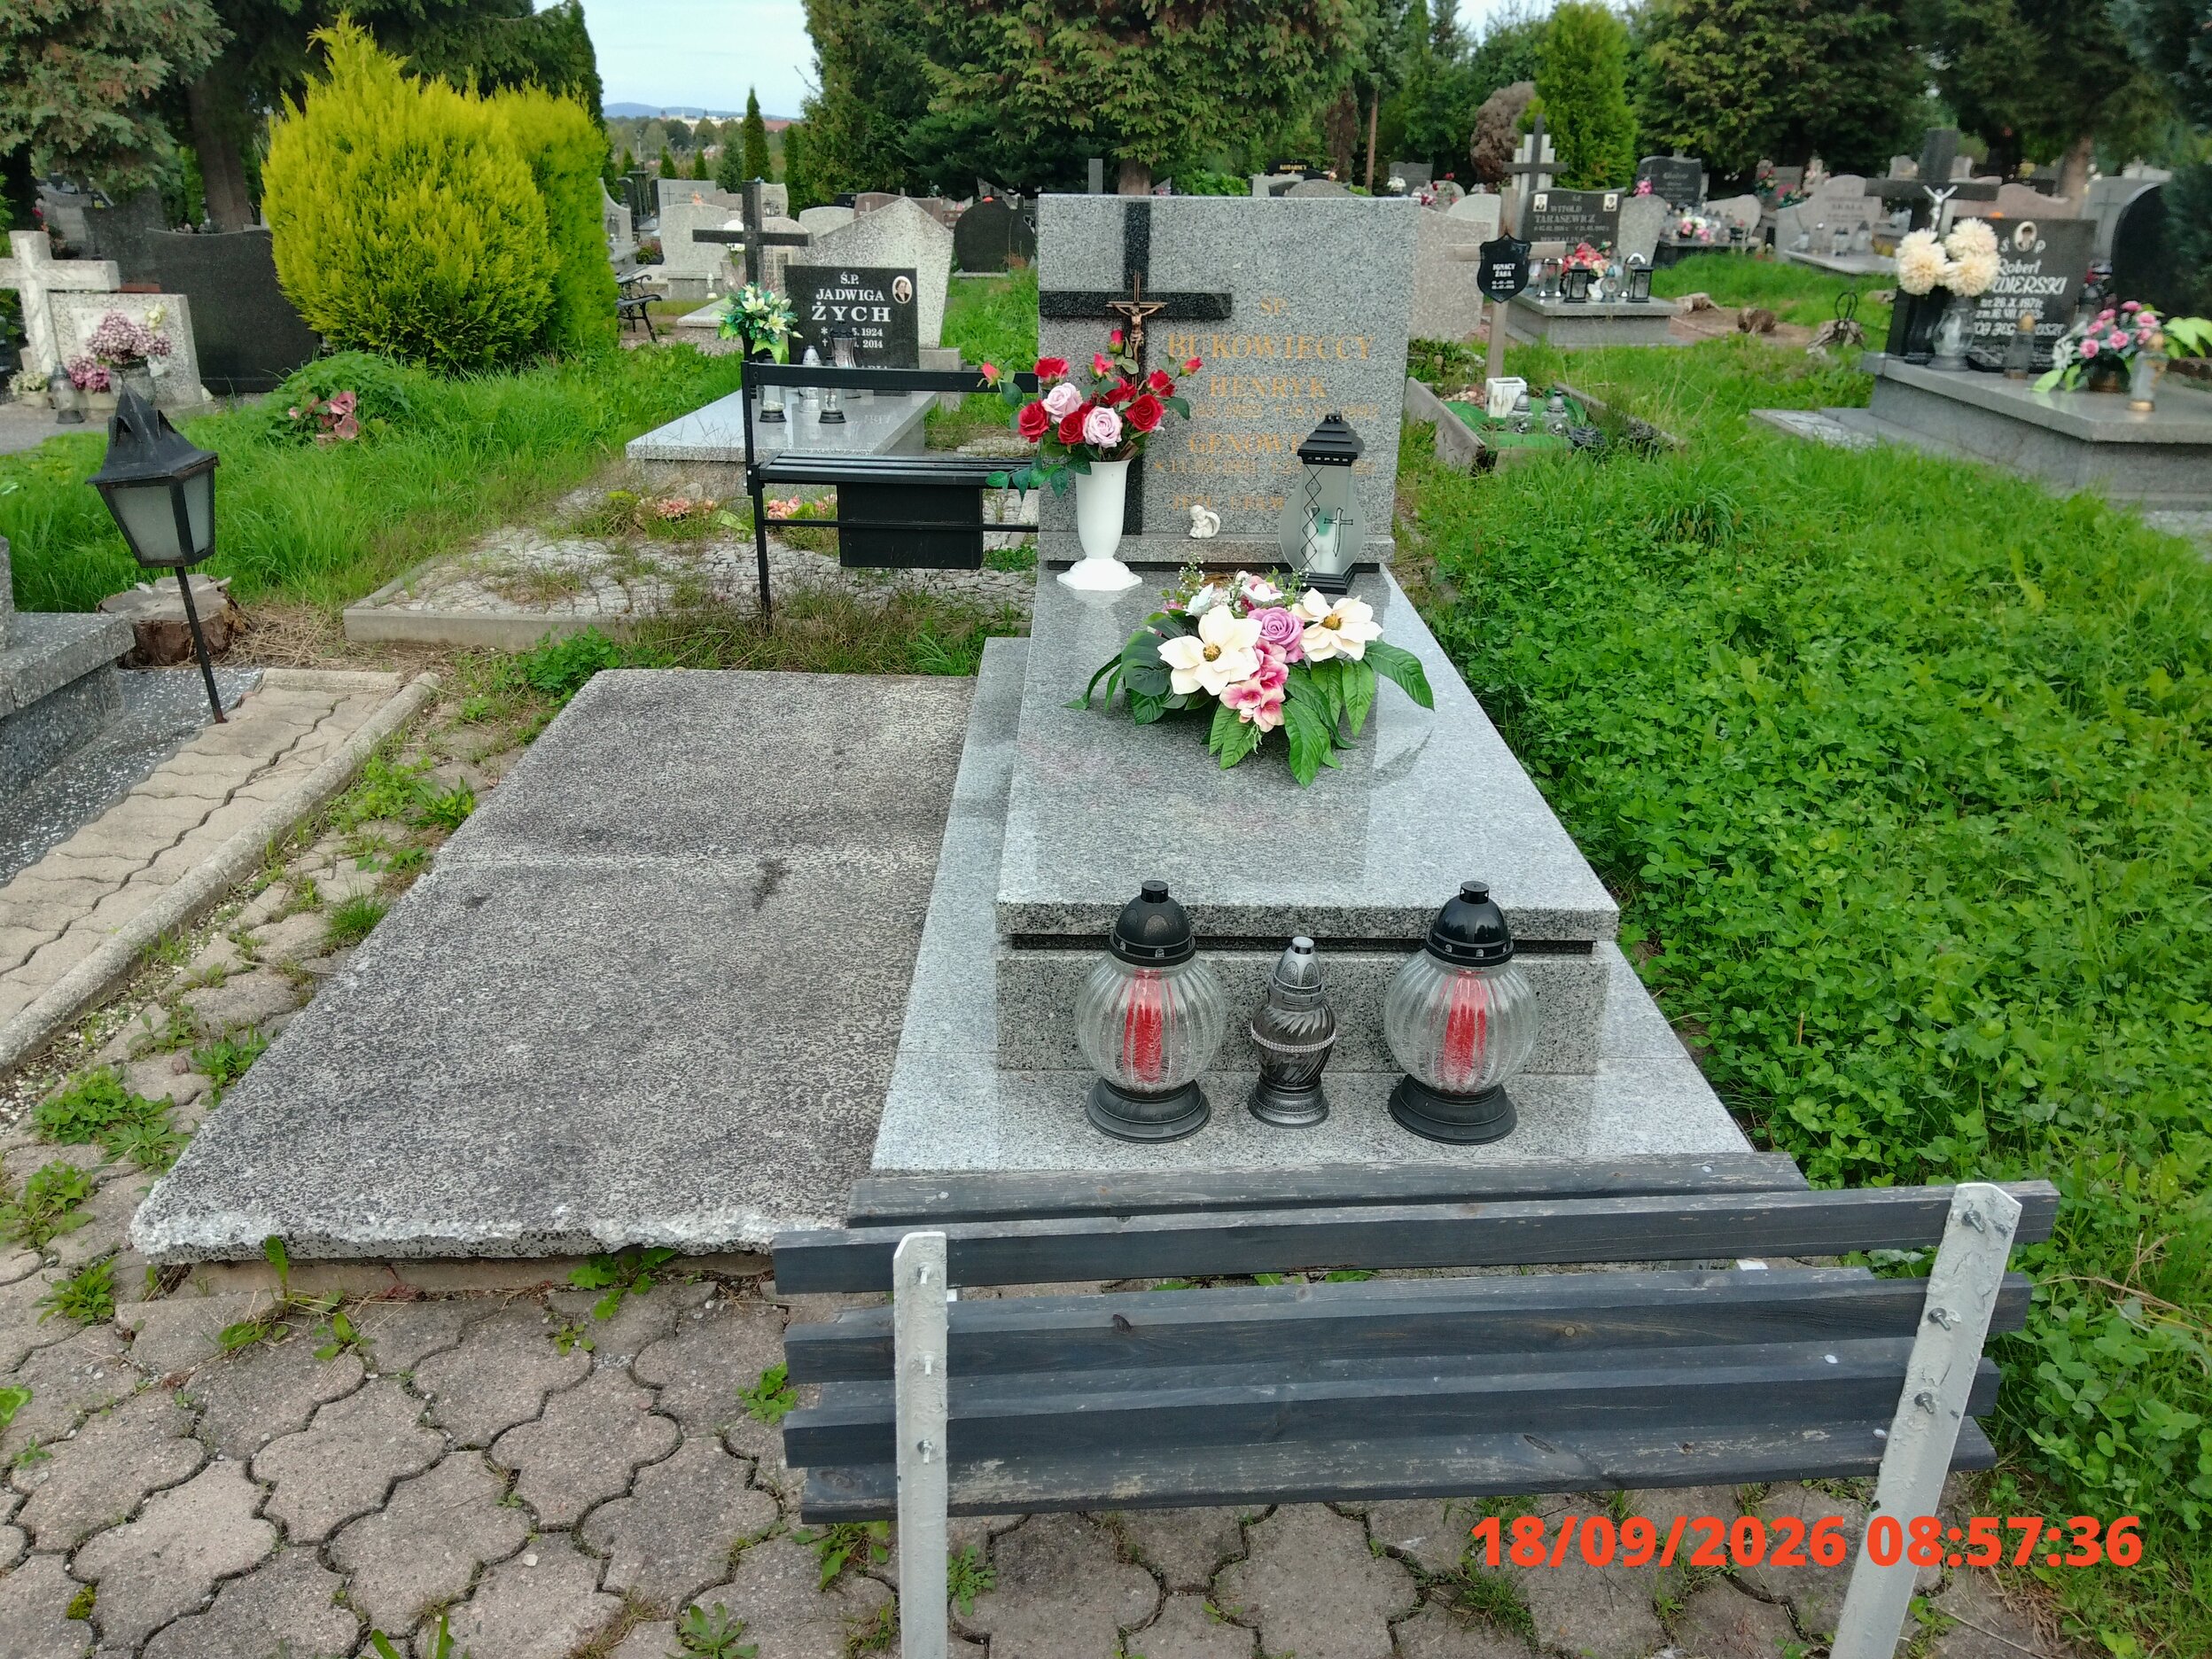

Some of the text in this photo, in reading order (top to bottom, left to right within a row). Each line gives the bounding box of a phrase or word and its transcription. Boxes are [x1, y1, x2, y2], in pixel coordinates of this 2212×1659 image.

[839, 271, 860, 285] Ś.P.
[815, 288, 885, 302] JADWIGA
[811, 301, 892, 323] ŻYCH
[1168, 333, 1375, 361] BUKOWIECCY
[1209, 374, 1328, 399] HENRYK
